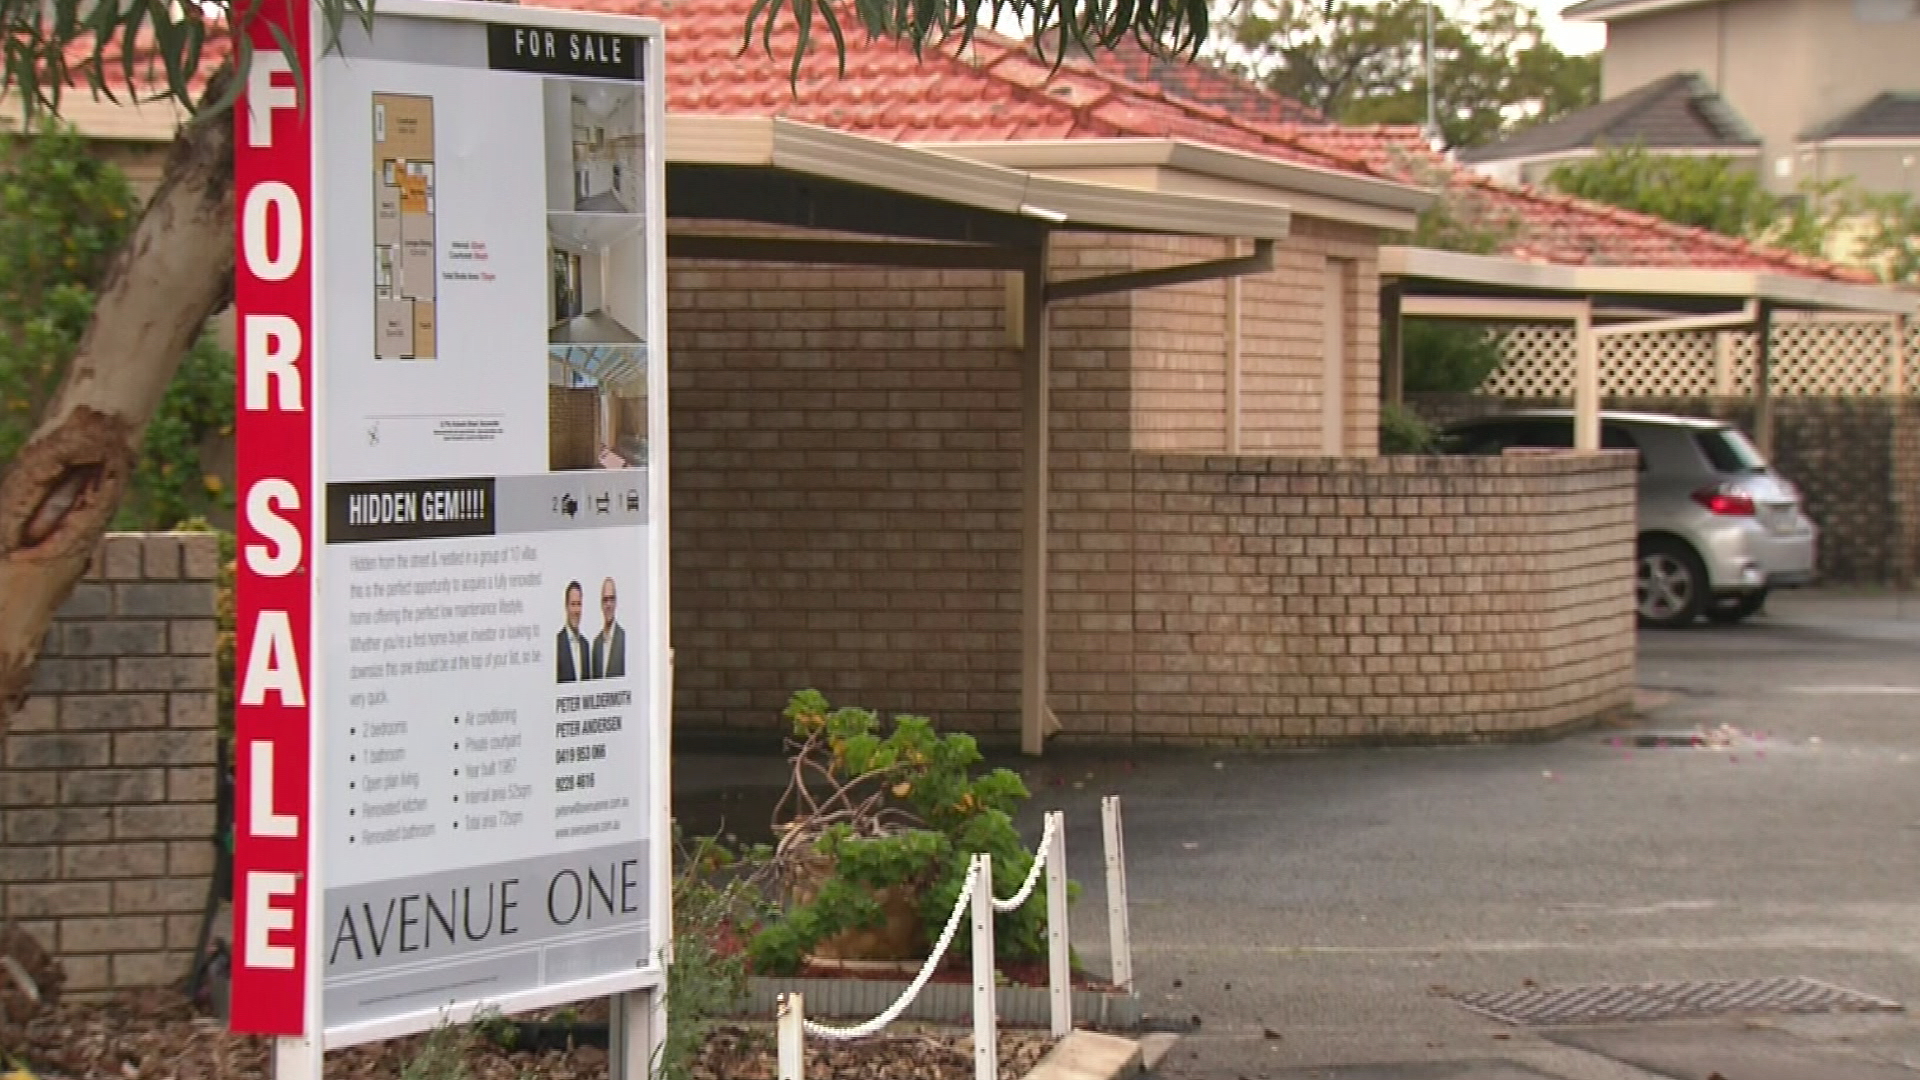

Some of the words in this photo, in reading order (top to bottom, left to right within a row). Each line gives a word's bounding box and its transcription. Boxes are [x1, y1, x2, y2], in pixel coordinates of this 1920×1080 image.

[515, 29, 555, 58] FOR
[570, 33, 621, 63] SALE
[243, 50, 304, 412] FOR
[350, 491, 416, 525] HIDDEN
[422, 489, 484, 522] GEM!!!!
[552, 496, 558, 513] 2
[556, 697, 580, 713] PETER
[240, 478, 306, 970] SALE
[556, 721, 580, 738] PETER
[582, 716, 622, 735] ANDERSEN
[330, 878, 519, 965] AVENUE
[548, 859, 638, 925] ONE
